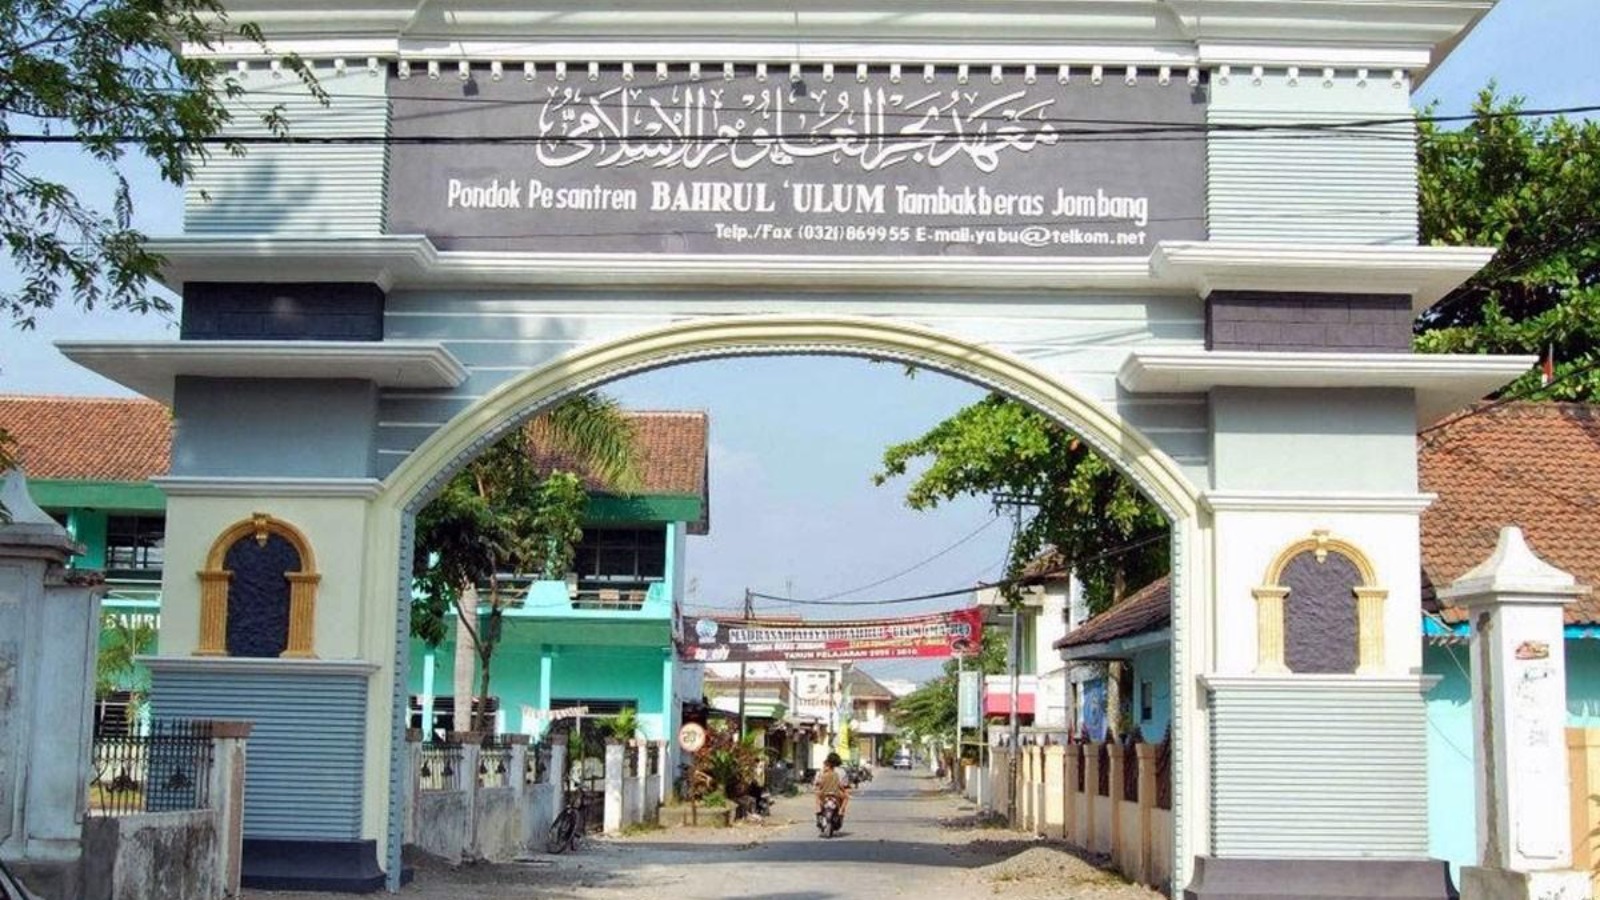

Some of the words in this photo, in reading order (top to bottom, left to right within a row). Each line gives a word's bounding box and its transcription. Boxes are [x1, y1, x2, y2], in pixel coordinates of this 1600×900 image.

[447, 178, 522, 209] Pondok
[527, 178, 637, 210] Pesantren
[650, 180, 776, 213] BAHRUL
[895, 184, 1045, 217] Tambakberas
[1051, 187, 1149, 226] Jombang
[714, 222, 794, 243] Telp./Fax
